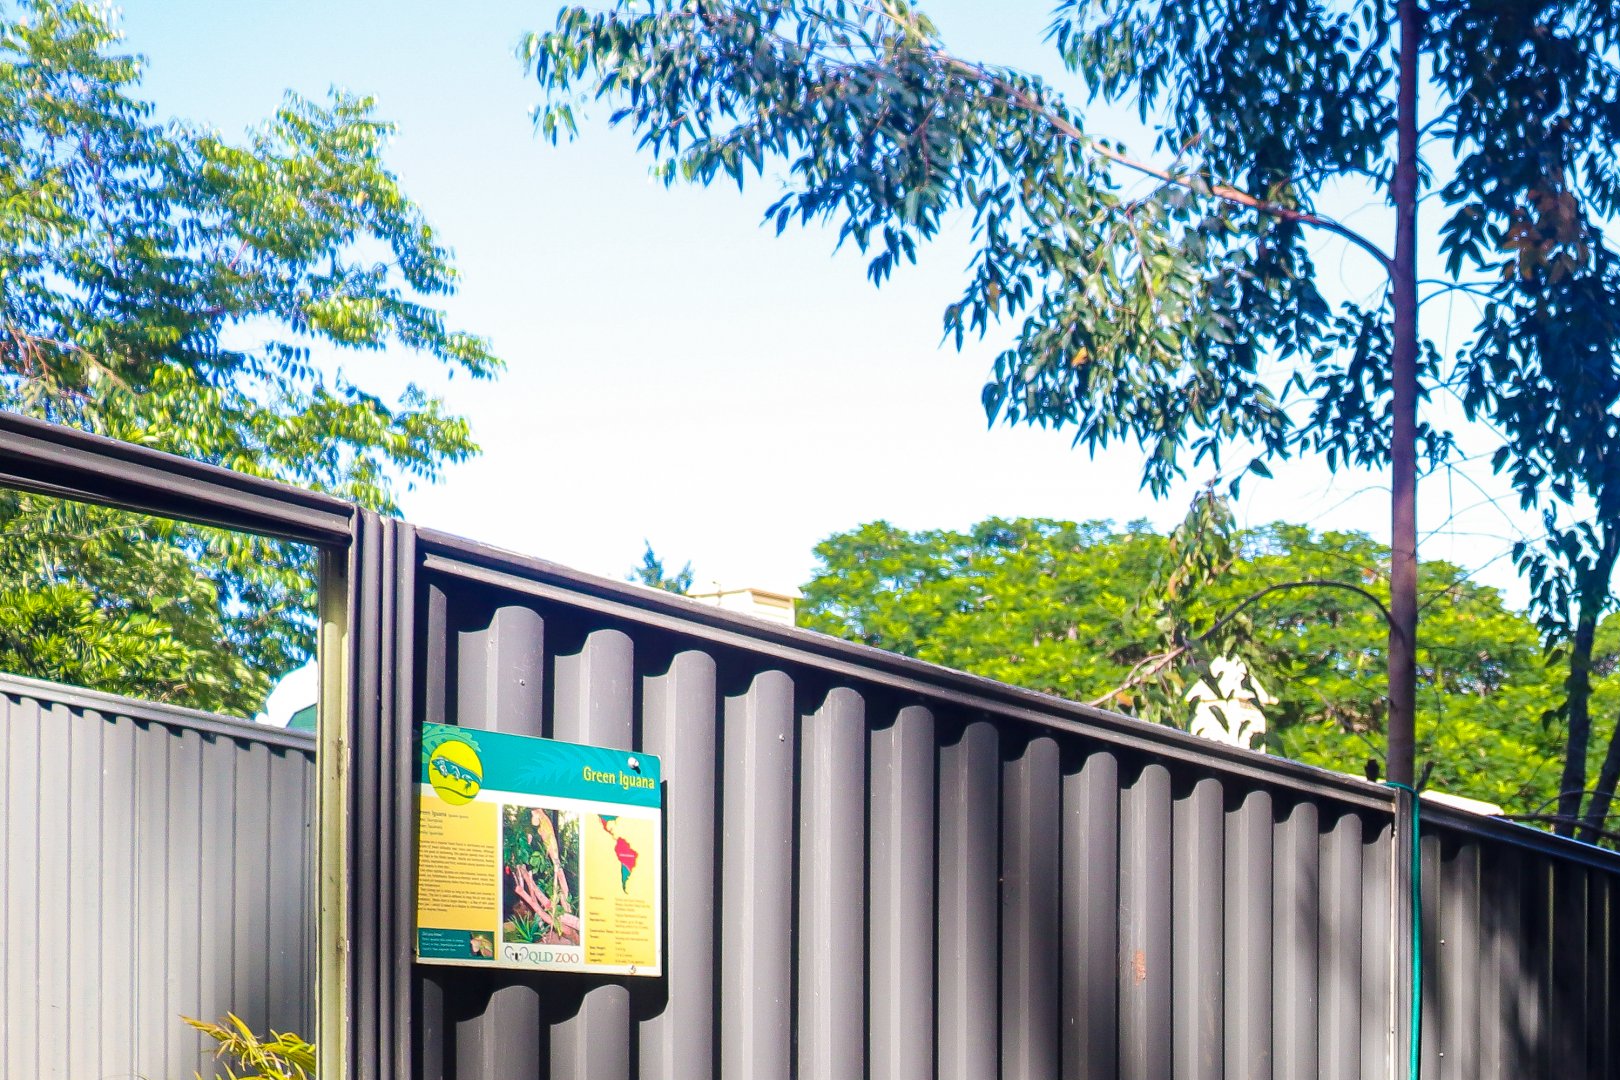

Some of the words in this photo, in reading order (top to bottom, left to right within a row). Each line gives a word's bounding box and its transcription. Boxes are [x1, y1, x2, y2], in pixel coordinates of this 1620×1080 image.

[583, 766, 616, 784] Green
[619, 769, 655, 790] Iguana
[529, 951, 553, 964] QLD
[555, 952, 579, 963] ZOO
